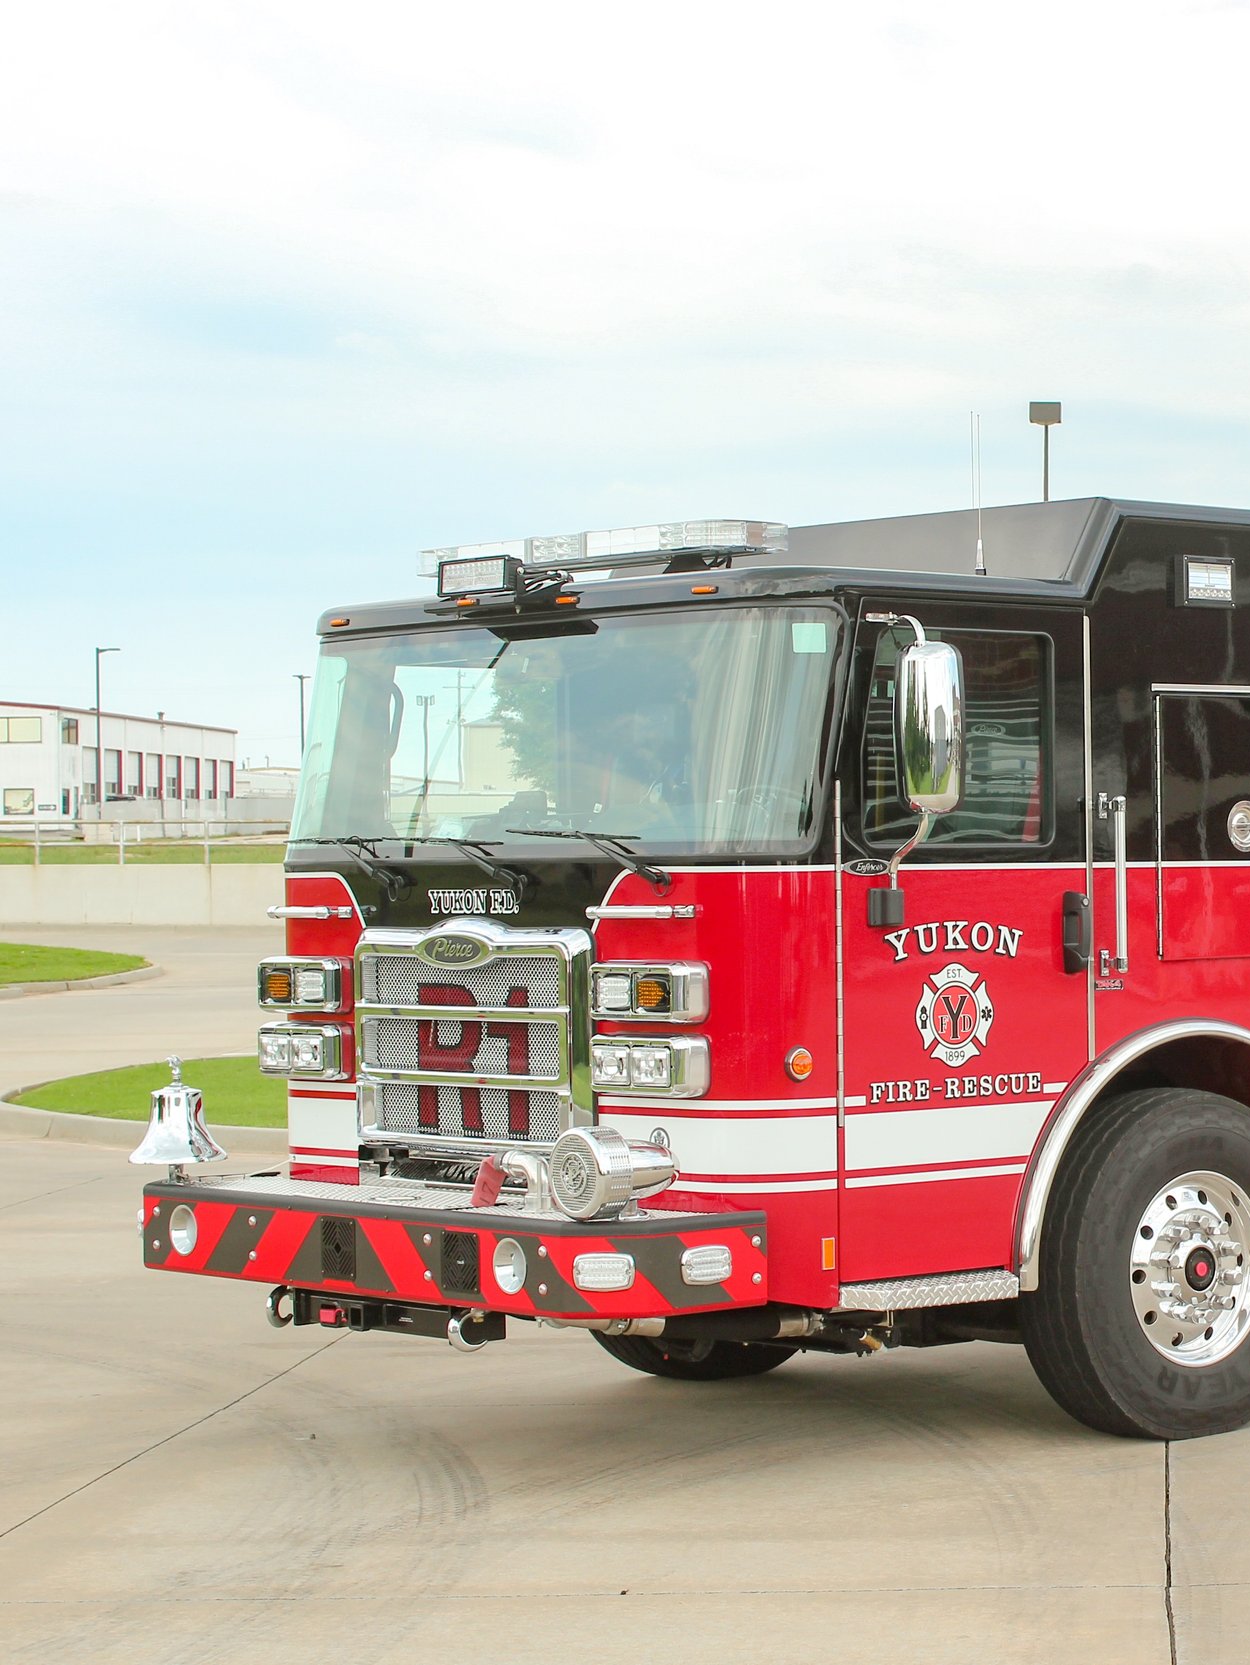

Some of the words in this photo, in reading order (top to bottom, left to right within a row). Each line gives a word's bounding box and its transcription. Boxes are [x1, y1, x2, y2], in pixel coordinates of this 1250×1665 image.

[428, 889, 487, 914] YUKON
[432, 937, 474, 960] Pierce
[884, 920, 1023, 962] YUKON
[946, 968, 963, 979] EST.
[418, 983, 529, 1136] R1
[945, 1050, 965, 1062] 1899
[870, 1072, 1041, 1104] FIRE-RESCUE
